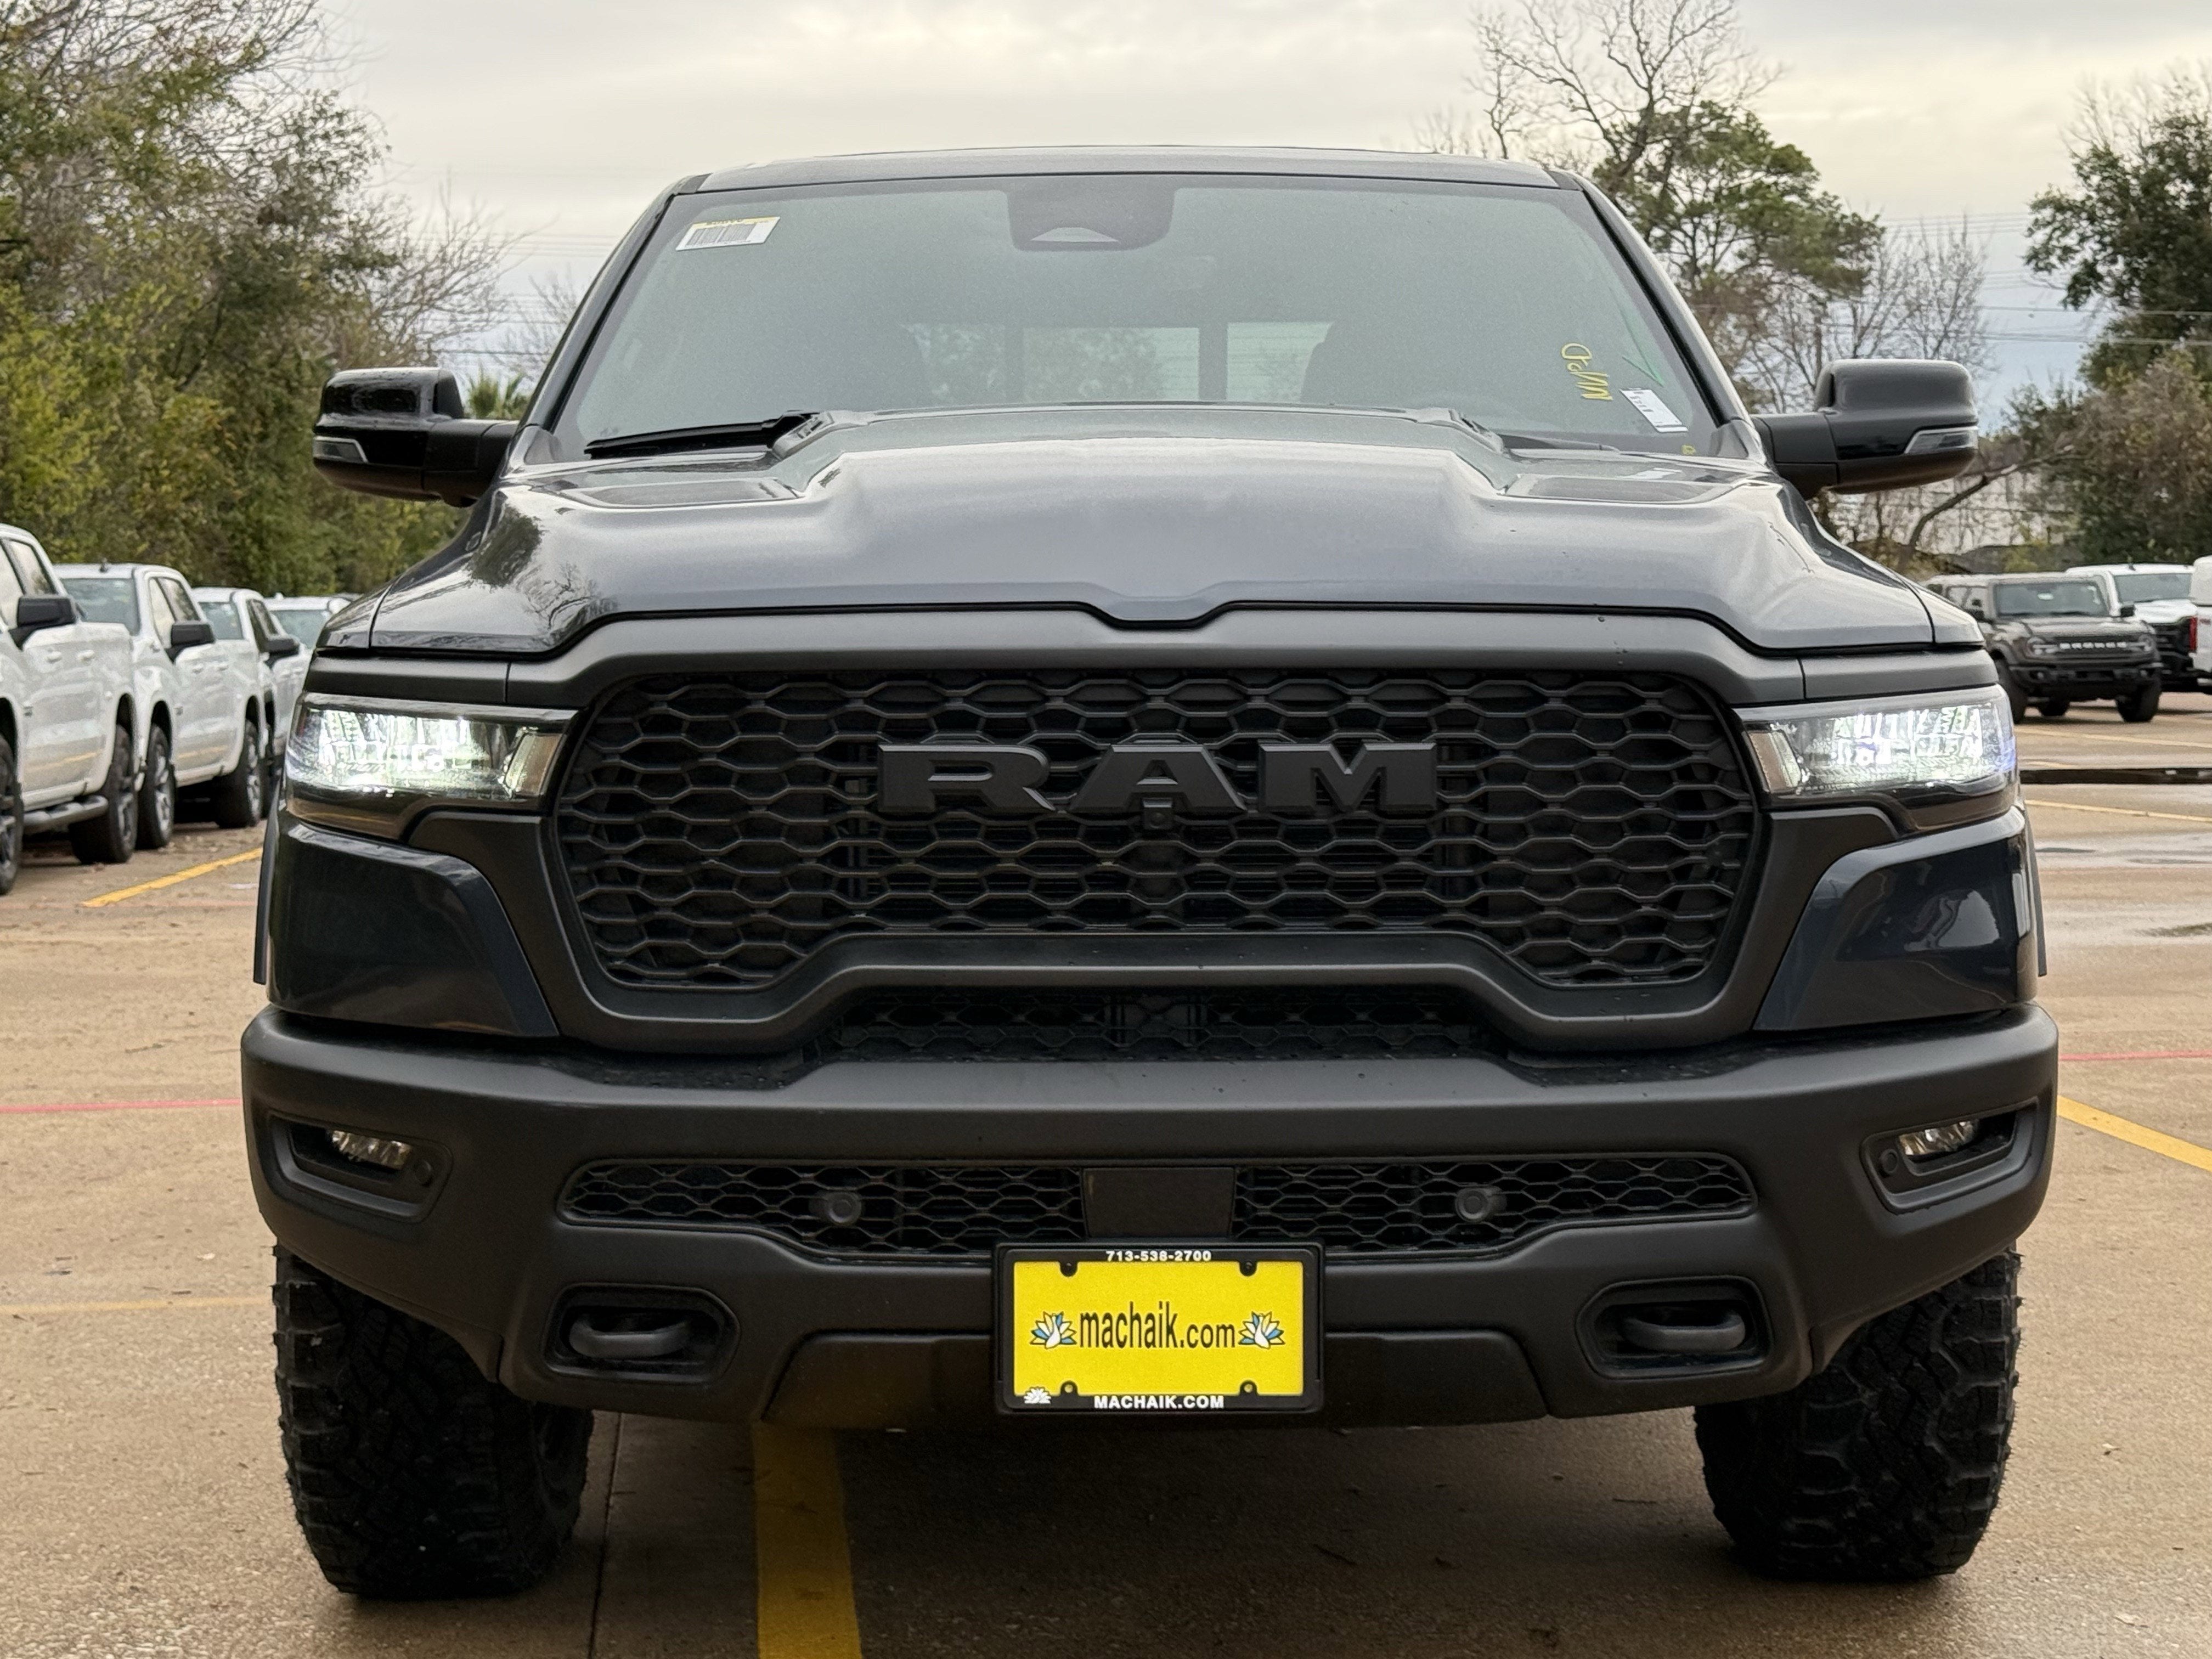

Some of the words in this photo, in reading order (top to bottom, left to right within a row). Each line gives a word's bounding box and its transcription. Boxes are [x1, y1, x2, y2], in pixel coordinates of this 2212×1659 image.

[878, 742, 1437, 812] RAM
[1079, 1301, 1235, 1349] machaik.com
[1094, 1395, 1224, 1409] MACHAIK.COM
